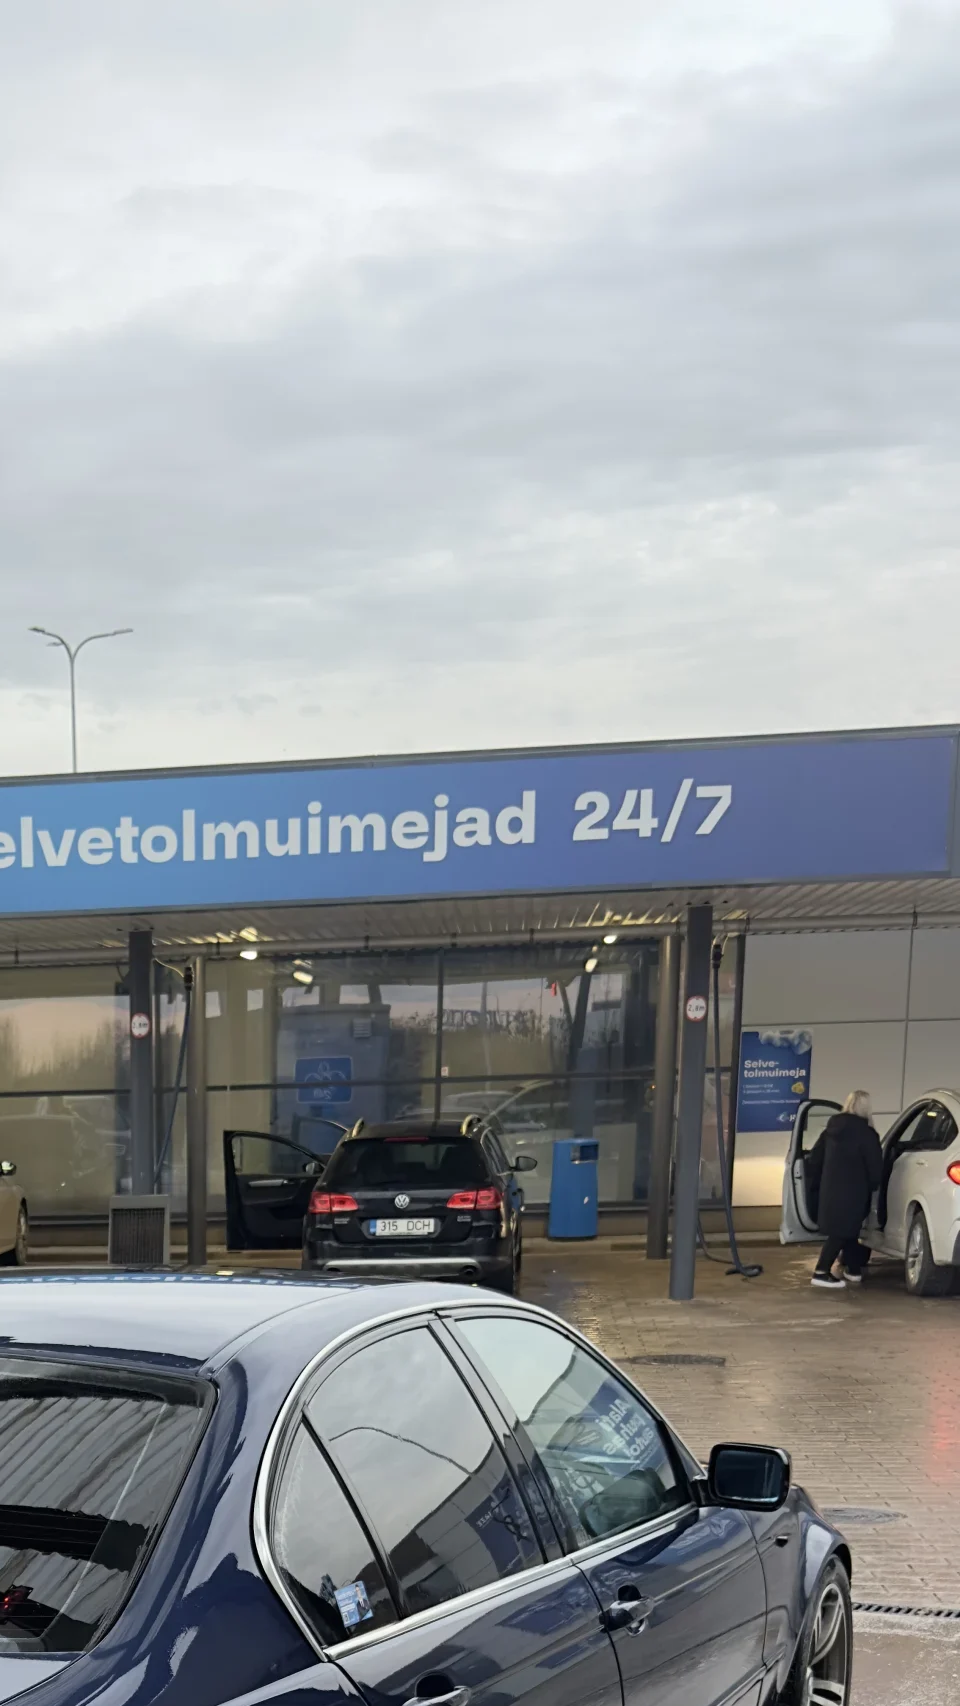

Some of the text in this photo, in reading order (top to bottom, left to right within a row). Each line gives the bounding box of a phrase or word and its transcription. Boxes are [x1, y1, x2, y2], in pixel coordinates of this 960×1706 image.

[572, 778, 734, 843] 24/7
[744, 1059, 779, 1068] Selve-
[743, 1067, 806, 1078] tolmuimeja
[381, 1220, 431, 1231] 315 DCH
